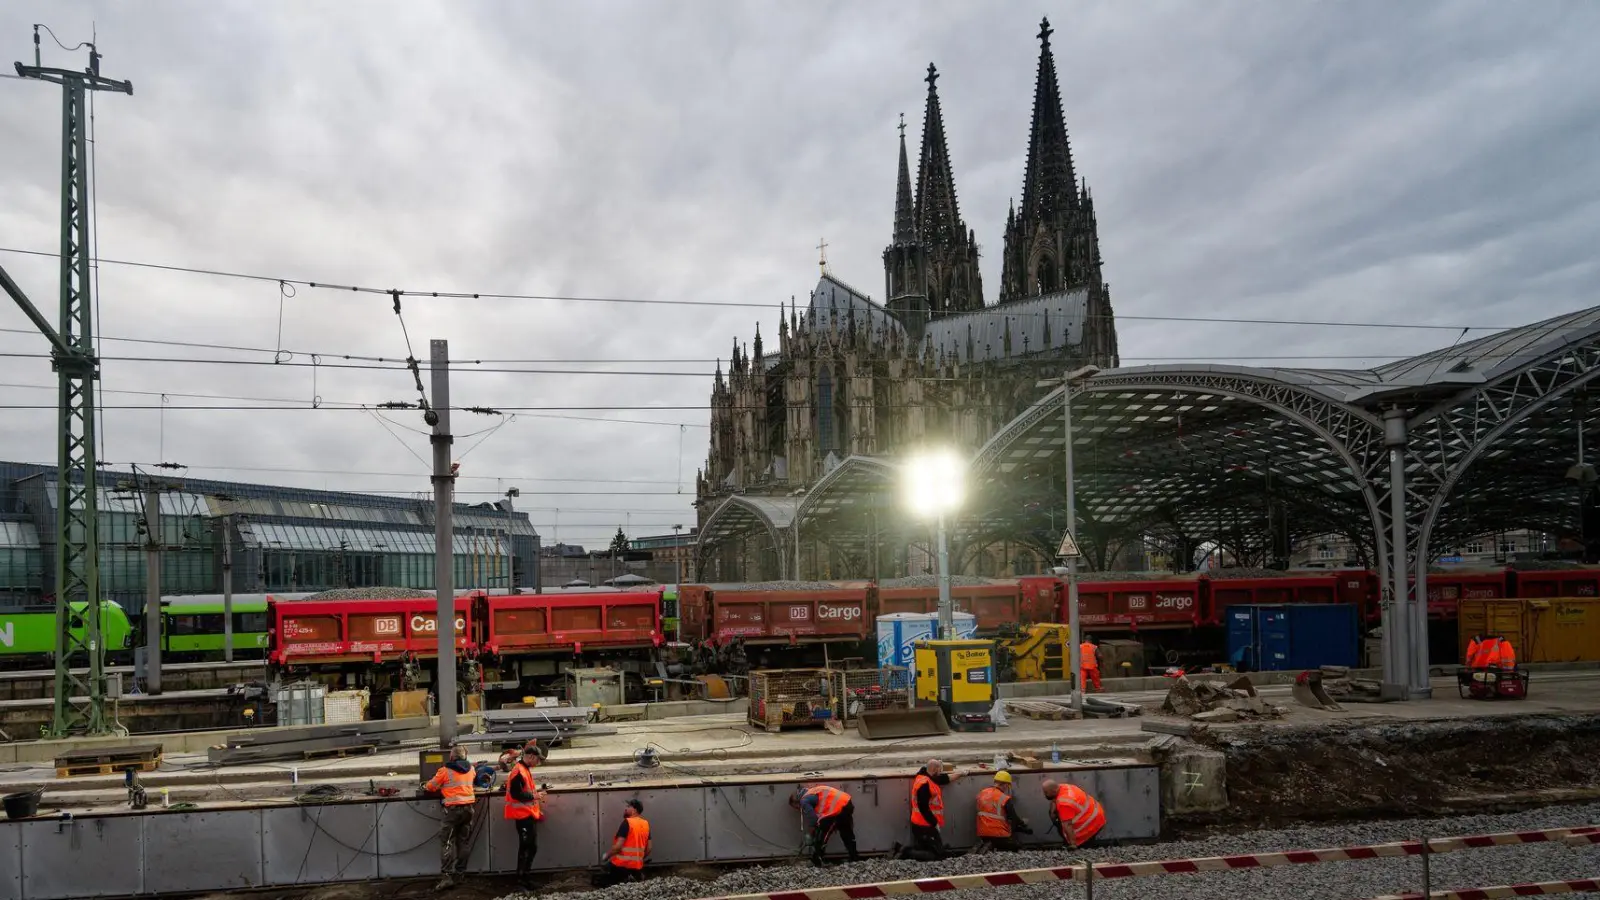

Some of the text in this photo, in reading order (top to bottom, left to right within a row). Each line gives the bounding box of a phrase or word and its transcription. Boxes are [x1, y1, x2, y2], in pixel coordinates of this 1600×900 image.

[1129, 595, 1193, 609] DB Cargo
[790, 605, 861, 620] DB Cargo
[377, 619, 397, 632] DB
[1182, 771, 1204, 796] 7
